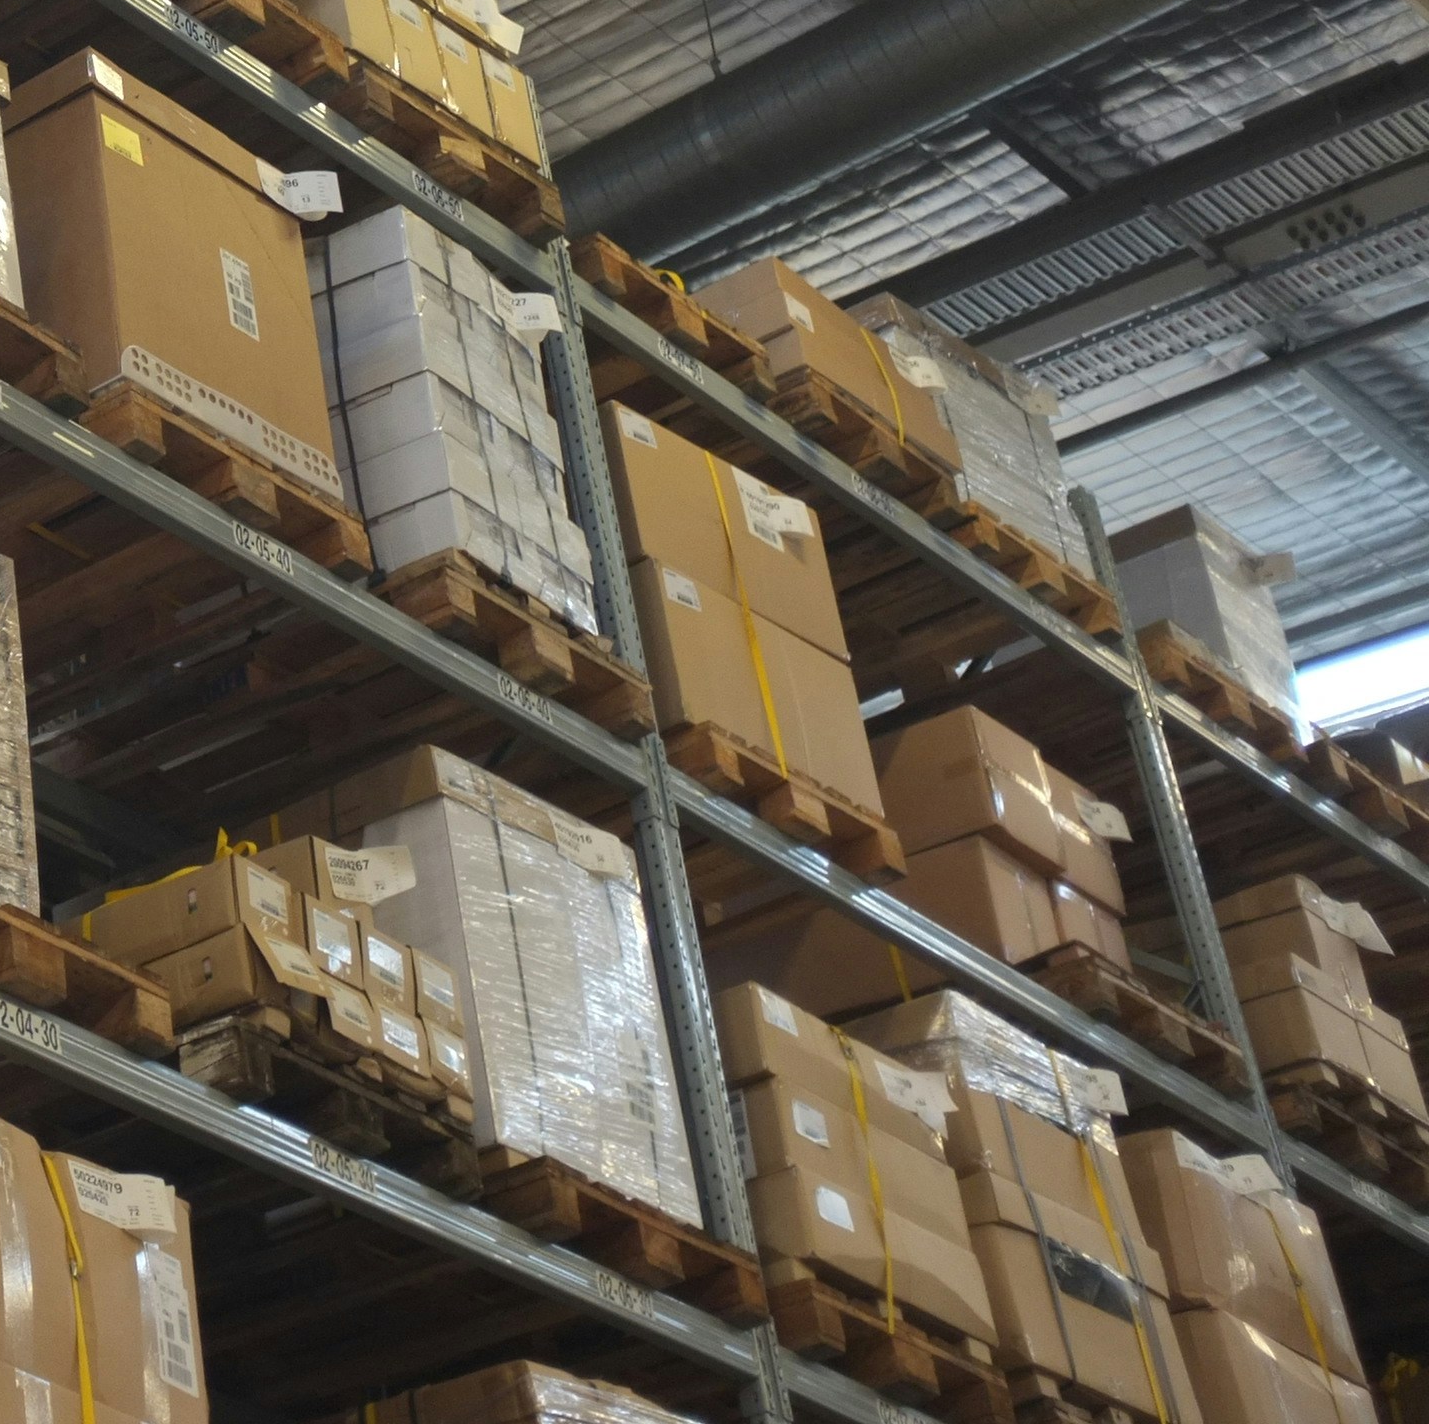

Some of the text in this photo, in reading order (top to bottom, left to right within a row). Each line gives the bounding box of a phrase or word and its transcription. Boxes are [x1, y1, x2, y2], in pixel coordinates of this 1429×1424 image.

[414, 174, 463, 219] 02-06-50
[235, 523, 291, 573] 02-05-40
[499, 675, 551, 723] 02-06-40
[313, 1143, 375, 1193] 02-05-30
[129, 1208, 140, 1217] 72
